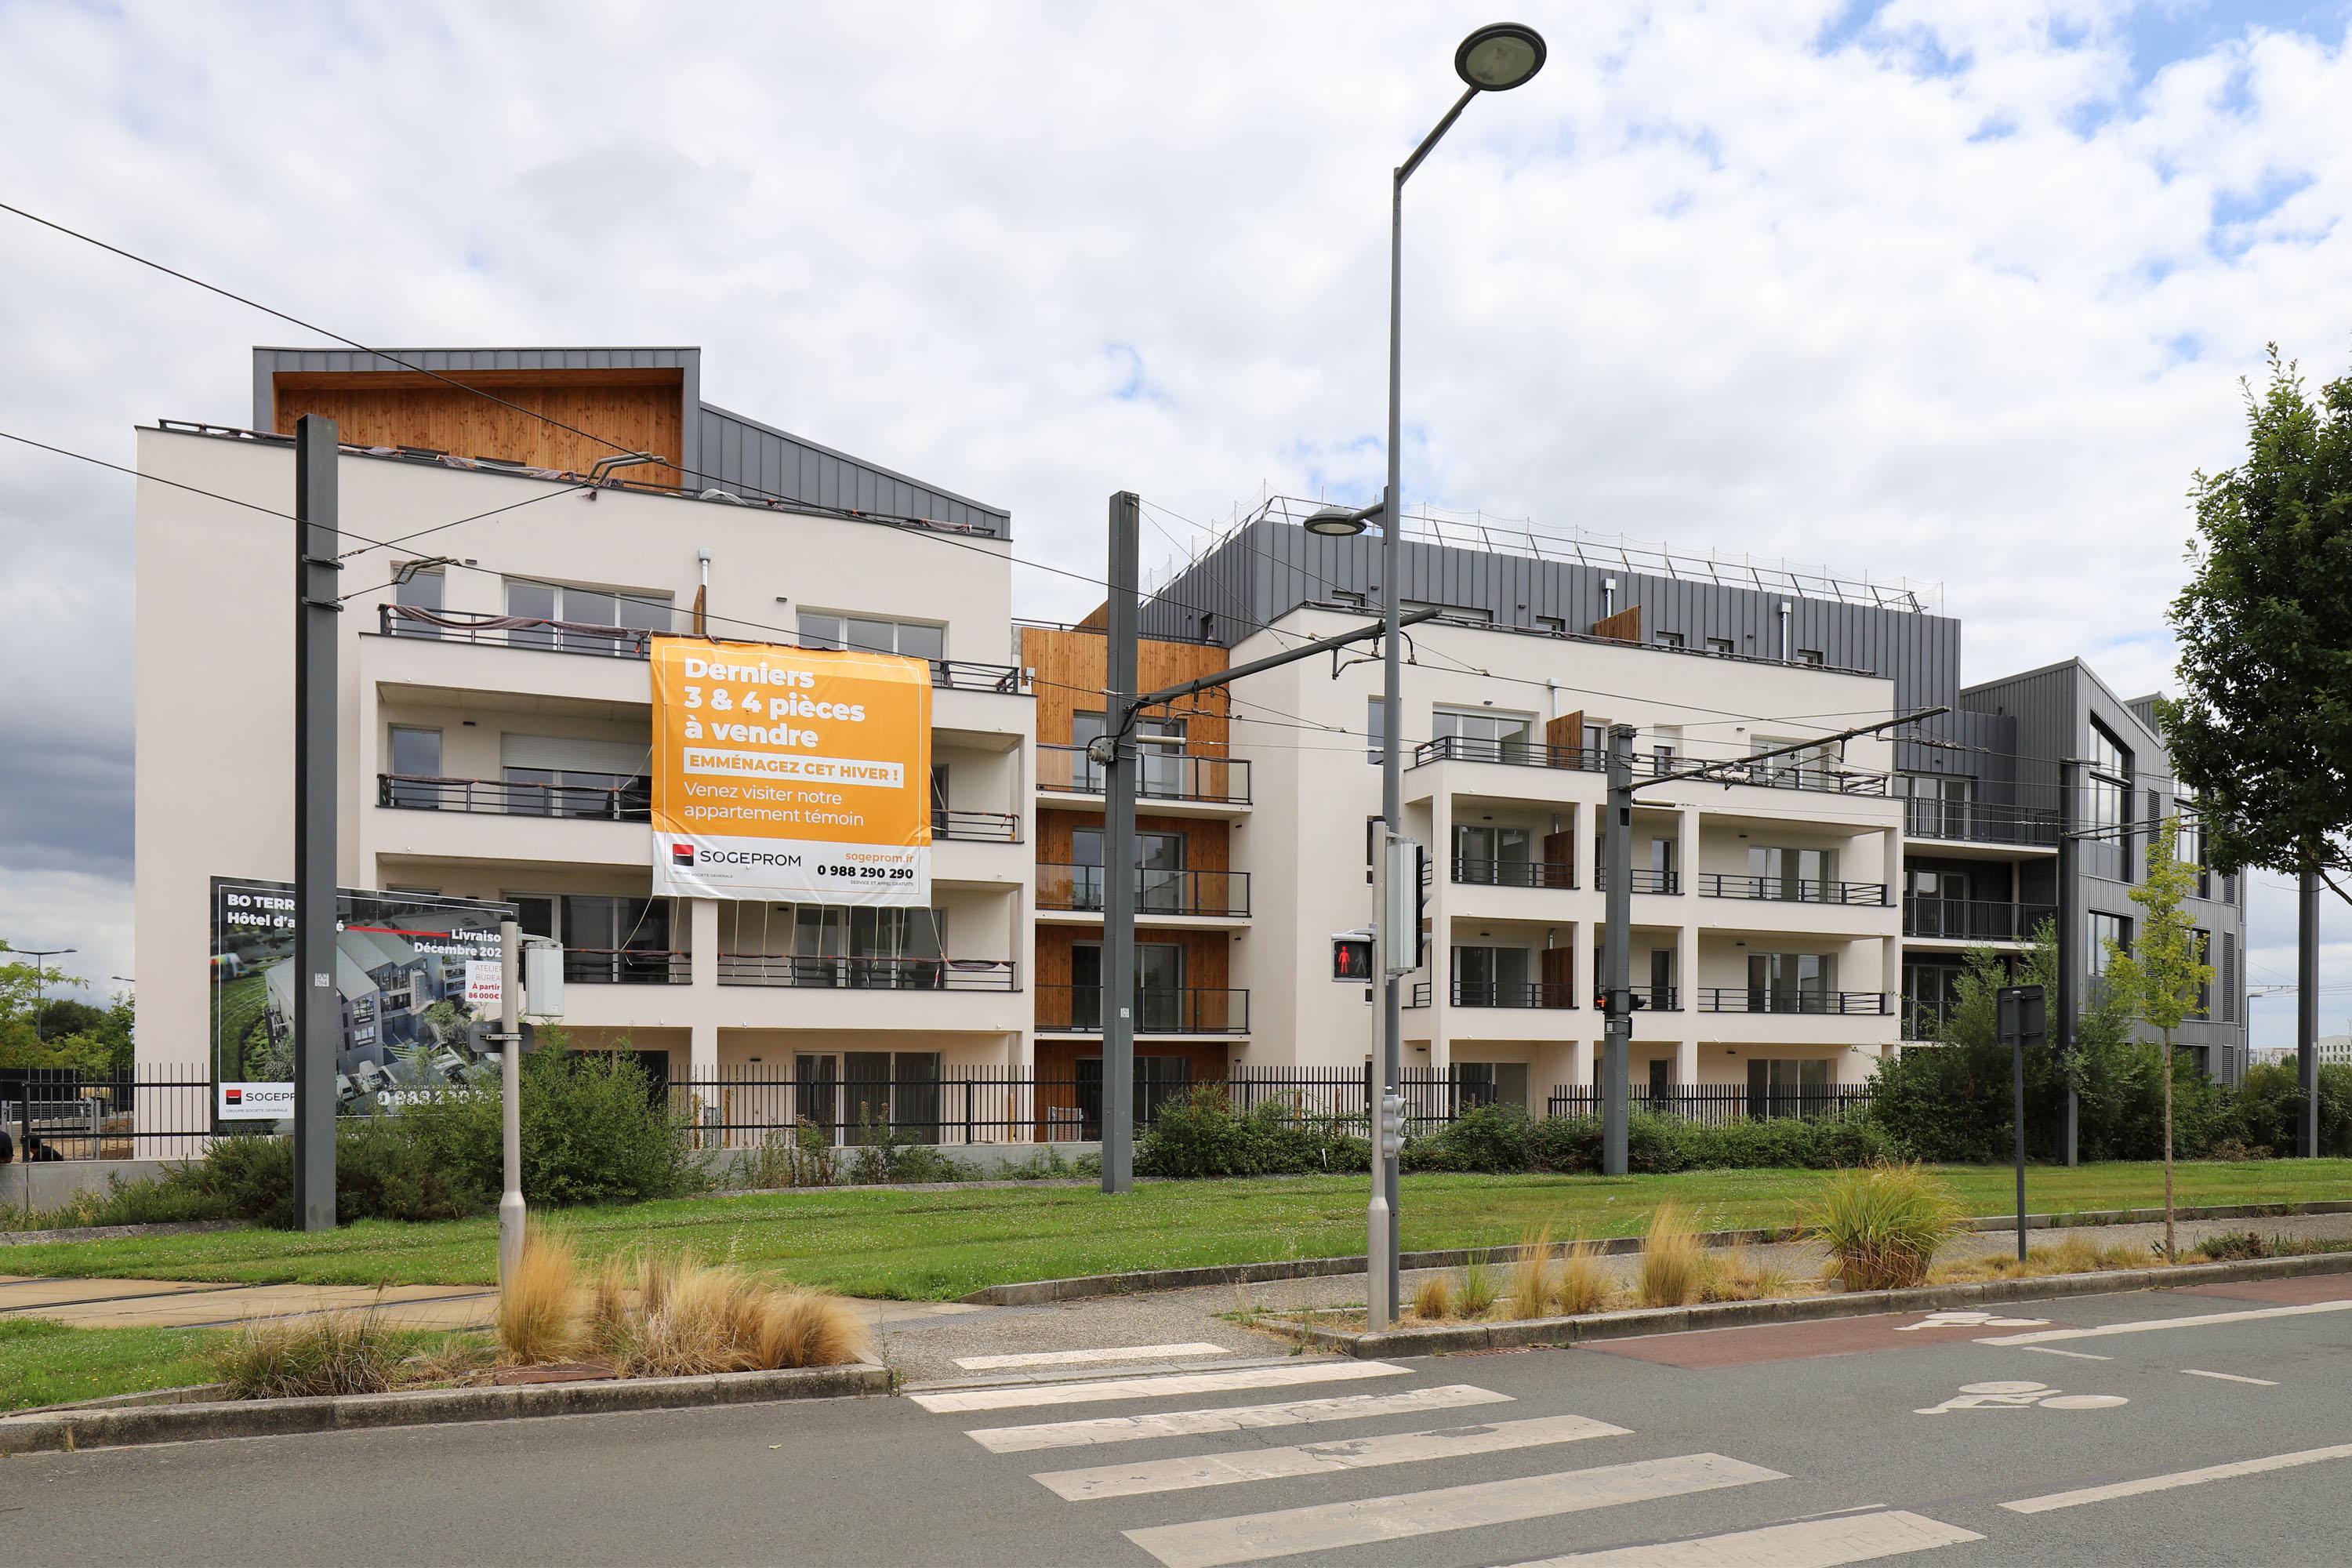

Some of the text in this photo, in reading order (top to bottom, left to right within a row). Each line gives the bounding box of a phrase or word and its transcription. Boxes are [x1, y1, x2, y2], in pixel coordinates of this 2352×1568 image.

[684, 658, 815, 688] Derniers
[684, 686, 866, 722] 3 & 4 pièces
[684, 714, 818, 748] à vendre
[690, 754, 898, 781] EMMÉNAGEZ CET HIVER !
[684, 782, 842, 805] Venez visiter notre
[684, 805, 864, 826] appartement témoin
[700, 851, 801, 867] SOGEPROM
[845, 852, 914, 863] sogeprom.fr
[817, 865, 913, 879] 0 988 290 290
[227, 894, 295, 911] BO TERR
[227, 912, 270, 927] Hôtel
[452, 928, 502, 942] Livraiso
[414, 942, 502, 957] Décembre 202
